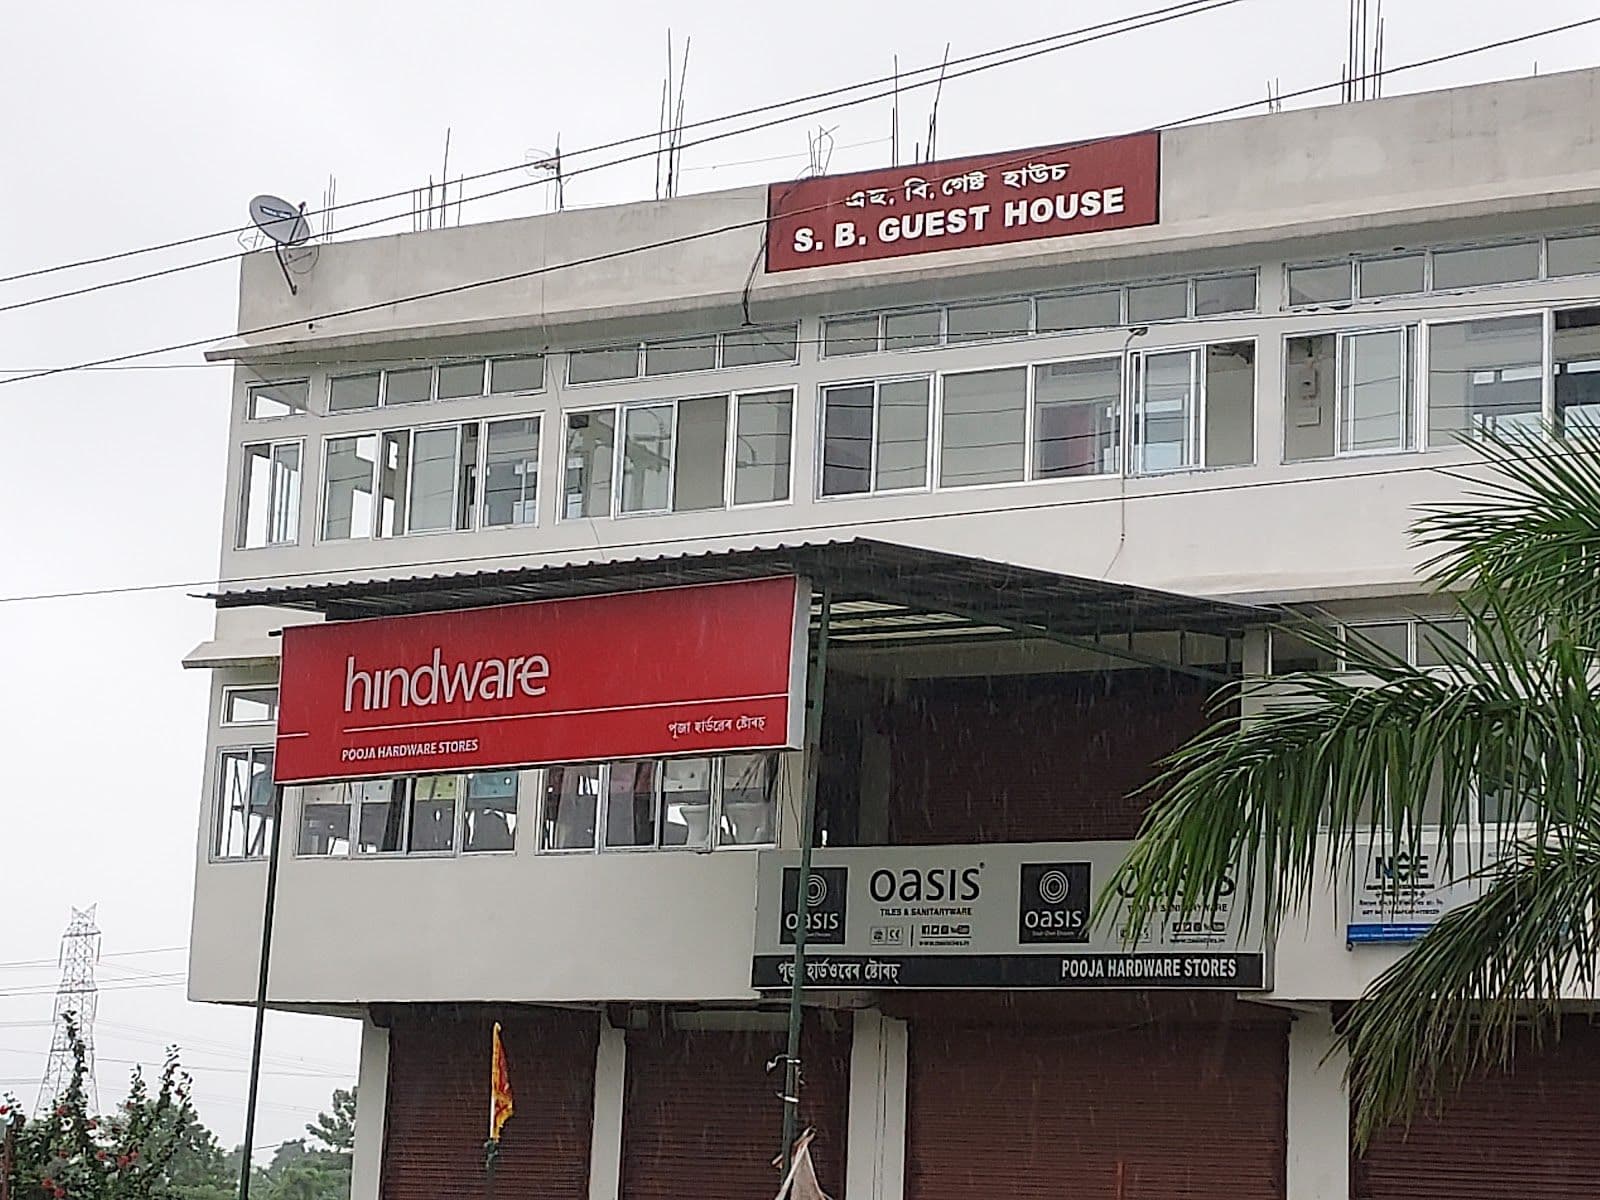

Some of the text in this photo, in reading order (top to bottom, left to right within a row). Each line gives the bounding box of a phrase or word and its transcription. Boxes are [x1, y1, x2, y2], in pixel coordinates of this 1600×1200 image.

[793, 187, 1125, 251] S. B. GUEST HOUSE
[344, 647, 550, 712] hindware
[342, 739, 479, 761] POOJA HARDWARE STORES
[869, 867, 980, 902] oasis
[1025, 910, 1082, 928] oasis
[1062, 958, 1237, 978] POOJA HARDWARE STORES
